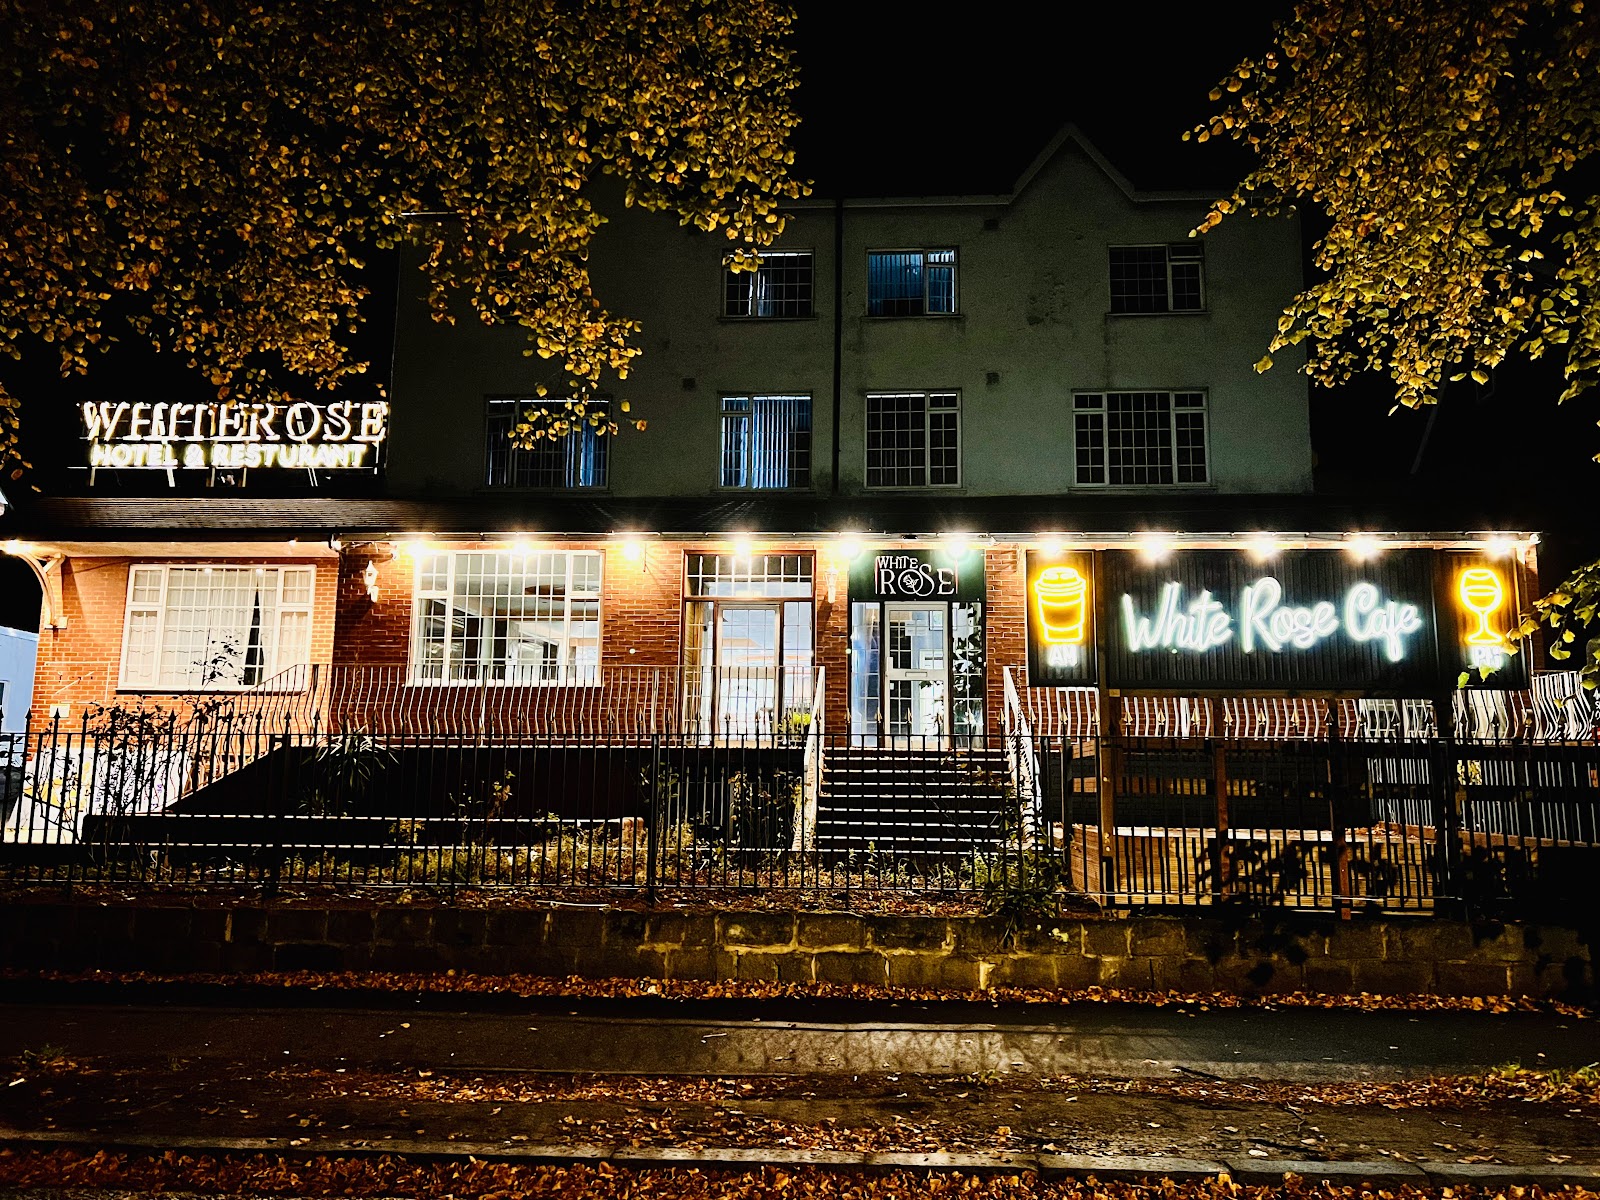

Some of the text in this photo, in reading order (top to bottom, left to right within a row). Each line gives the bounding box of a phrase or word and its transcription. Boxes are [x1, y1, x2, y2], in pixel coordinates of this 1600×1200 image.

[91, 444, 367, 467] HOTEL & RESTURANT
[878, 556, 919, 569] WHITE
[880, 563, 955, 597] ROSE
[1121, 576, 1422, 663] White Rose Cafe
[1048, 645, 1078, 667] AM
